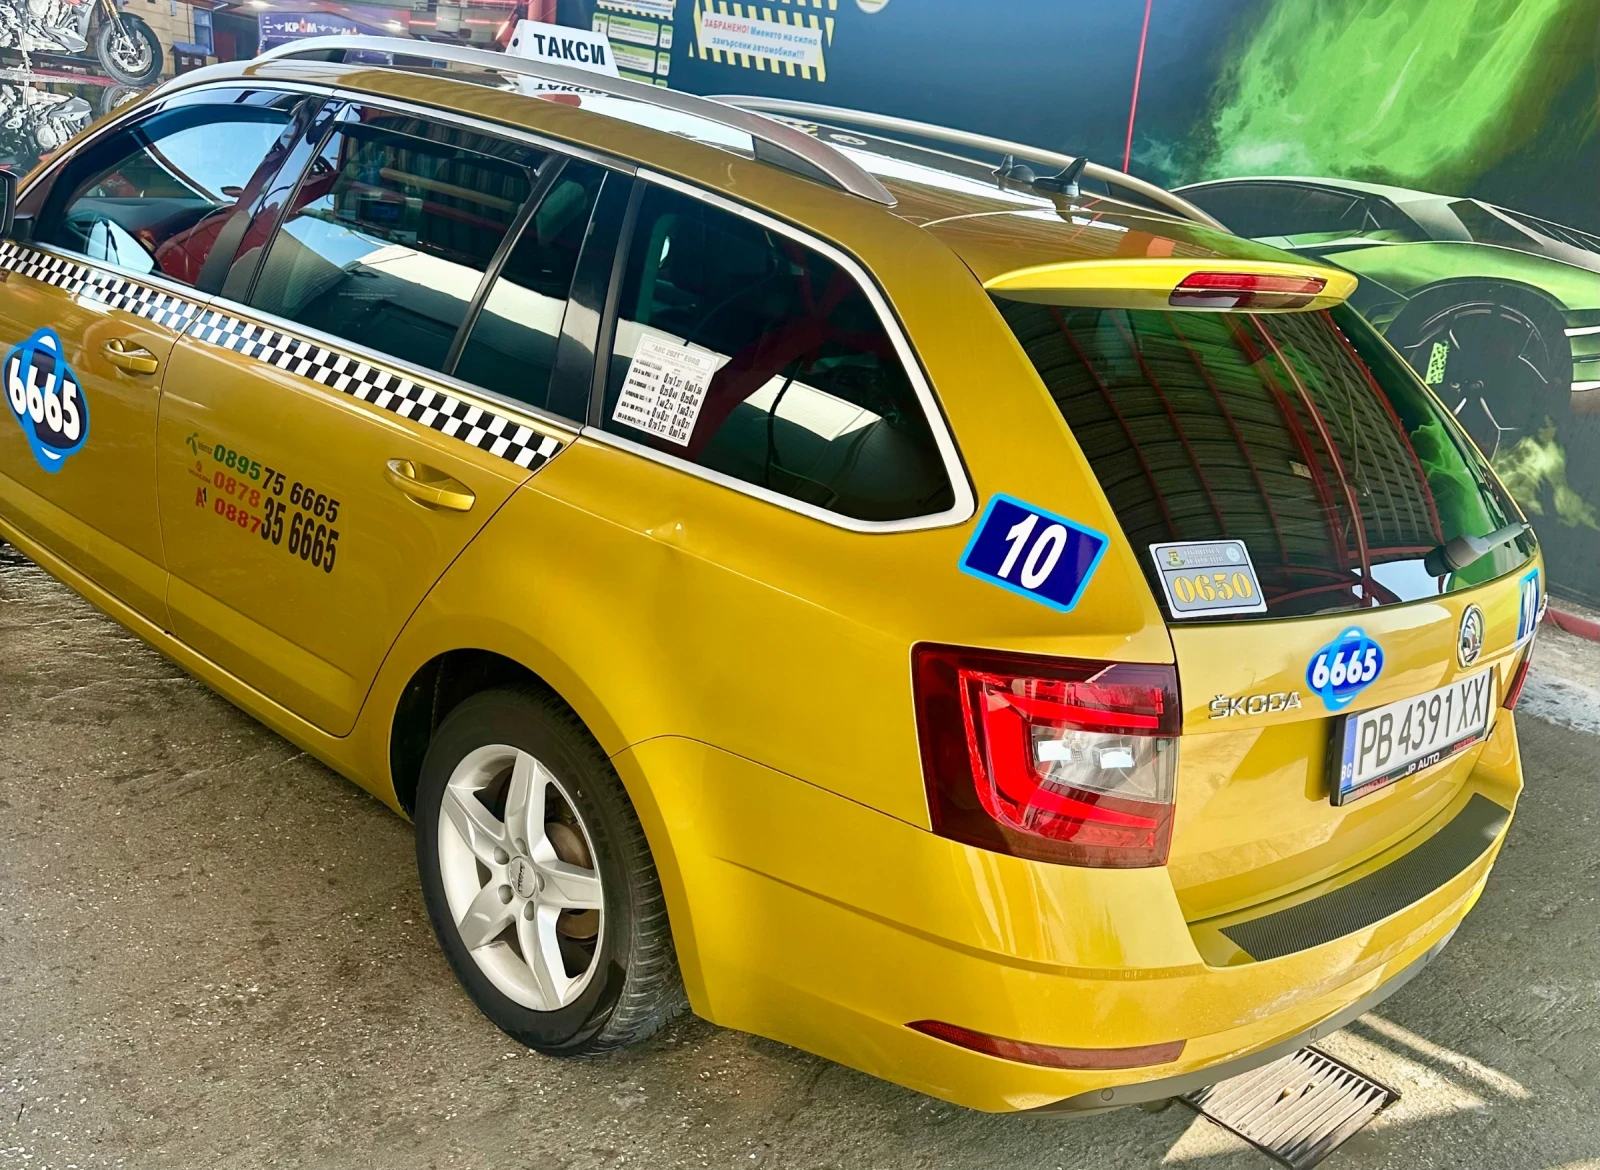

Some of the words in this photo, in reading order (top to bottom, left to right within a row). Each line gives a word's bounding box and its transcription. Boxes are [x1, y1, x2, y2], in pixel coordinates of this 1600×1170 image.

[533, 33, 606, 66] ТАКСИ
[704, 18, 750, 34] ЗАБРАНЕНО!
[750, 26, 782, 40] Миенето
[783, 33, 793, 42] на
[793, 35, 818, 46] силно
[712, 37, 752, 50] замърсени
[9, 357, 81, 441] 6665
[213, 444, 262, 480] 0895
[262, 467, 287, 496] 75
[289, 482, 341, 523] 6665
[213, 471, 261, 508] 0878
[214, 497, 262, 534] 0887
[260, 496, 287, 545] 35
[288, 512, 340, 573] 6665
[997, 513, 1068, 589] 10
[1173, 572, 1252, 603] 0650
[1312, 648, 1377, 689] 6665
[1208, 693, 1302, 720] ŠKODA
[1358, 712, 1394, 776] PB
[1398, 688, 1454, 755] 4391
[1456, 675, 1486, 732] XX
[1341, 762, 1353, 780] BG
[1405, 763, 1417, 776] JP
[1417, 752, 1440, 770] AUTO
